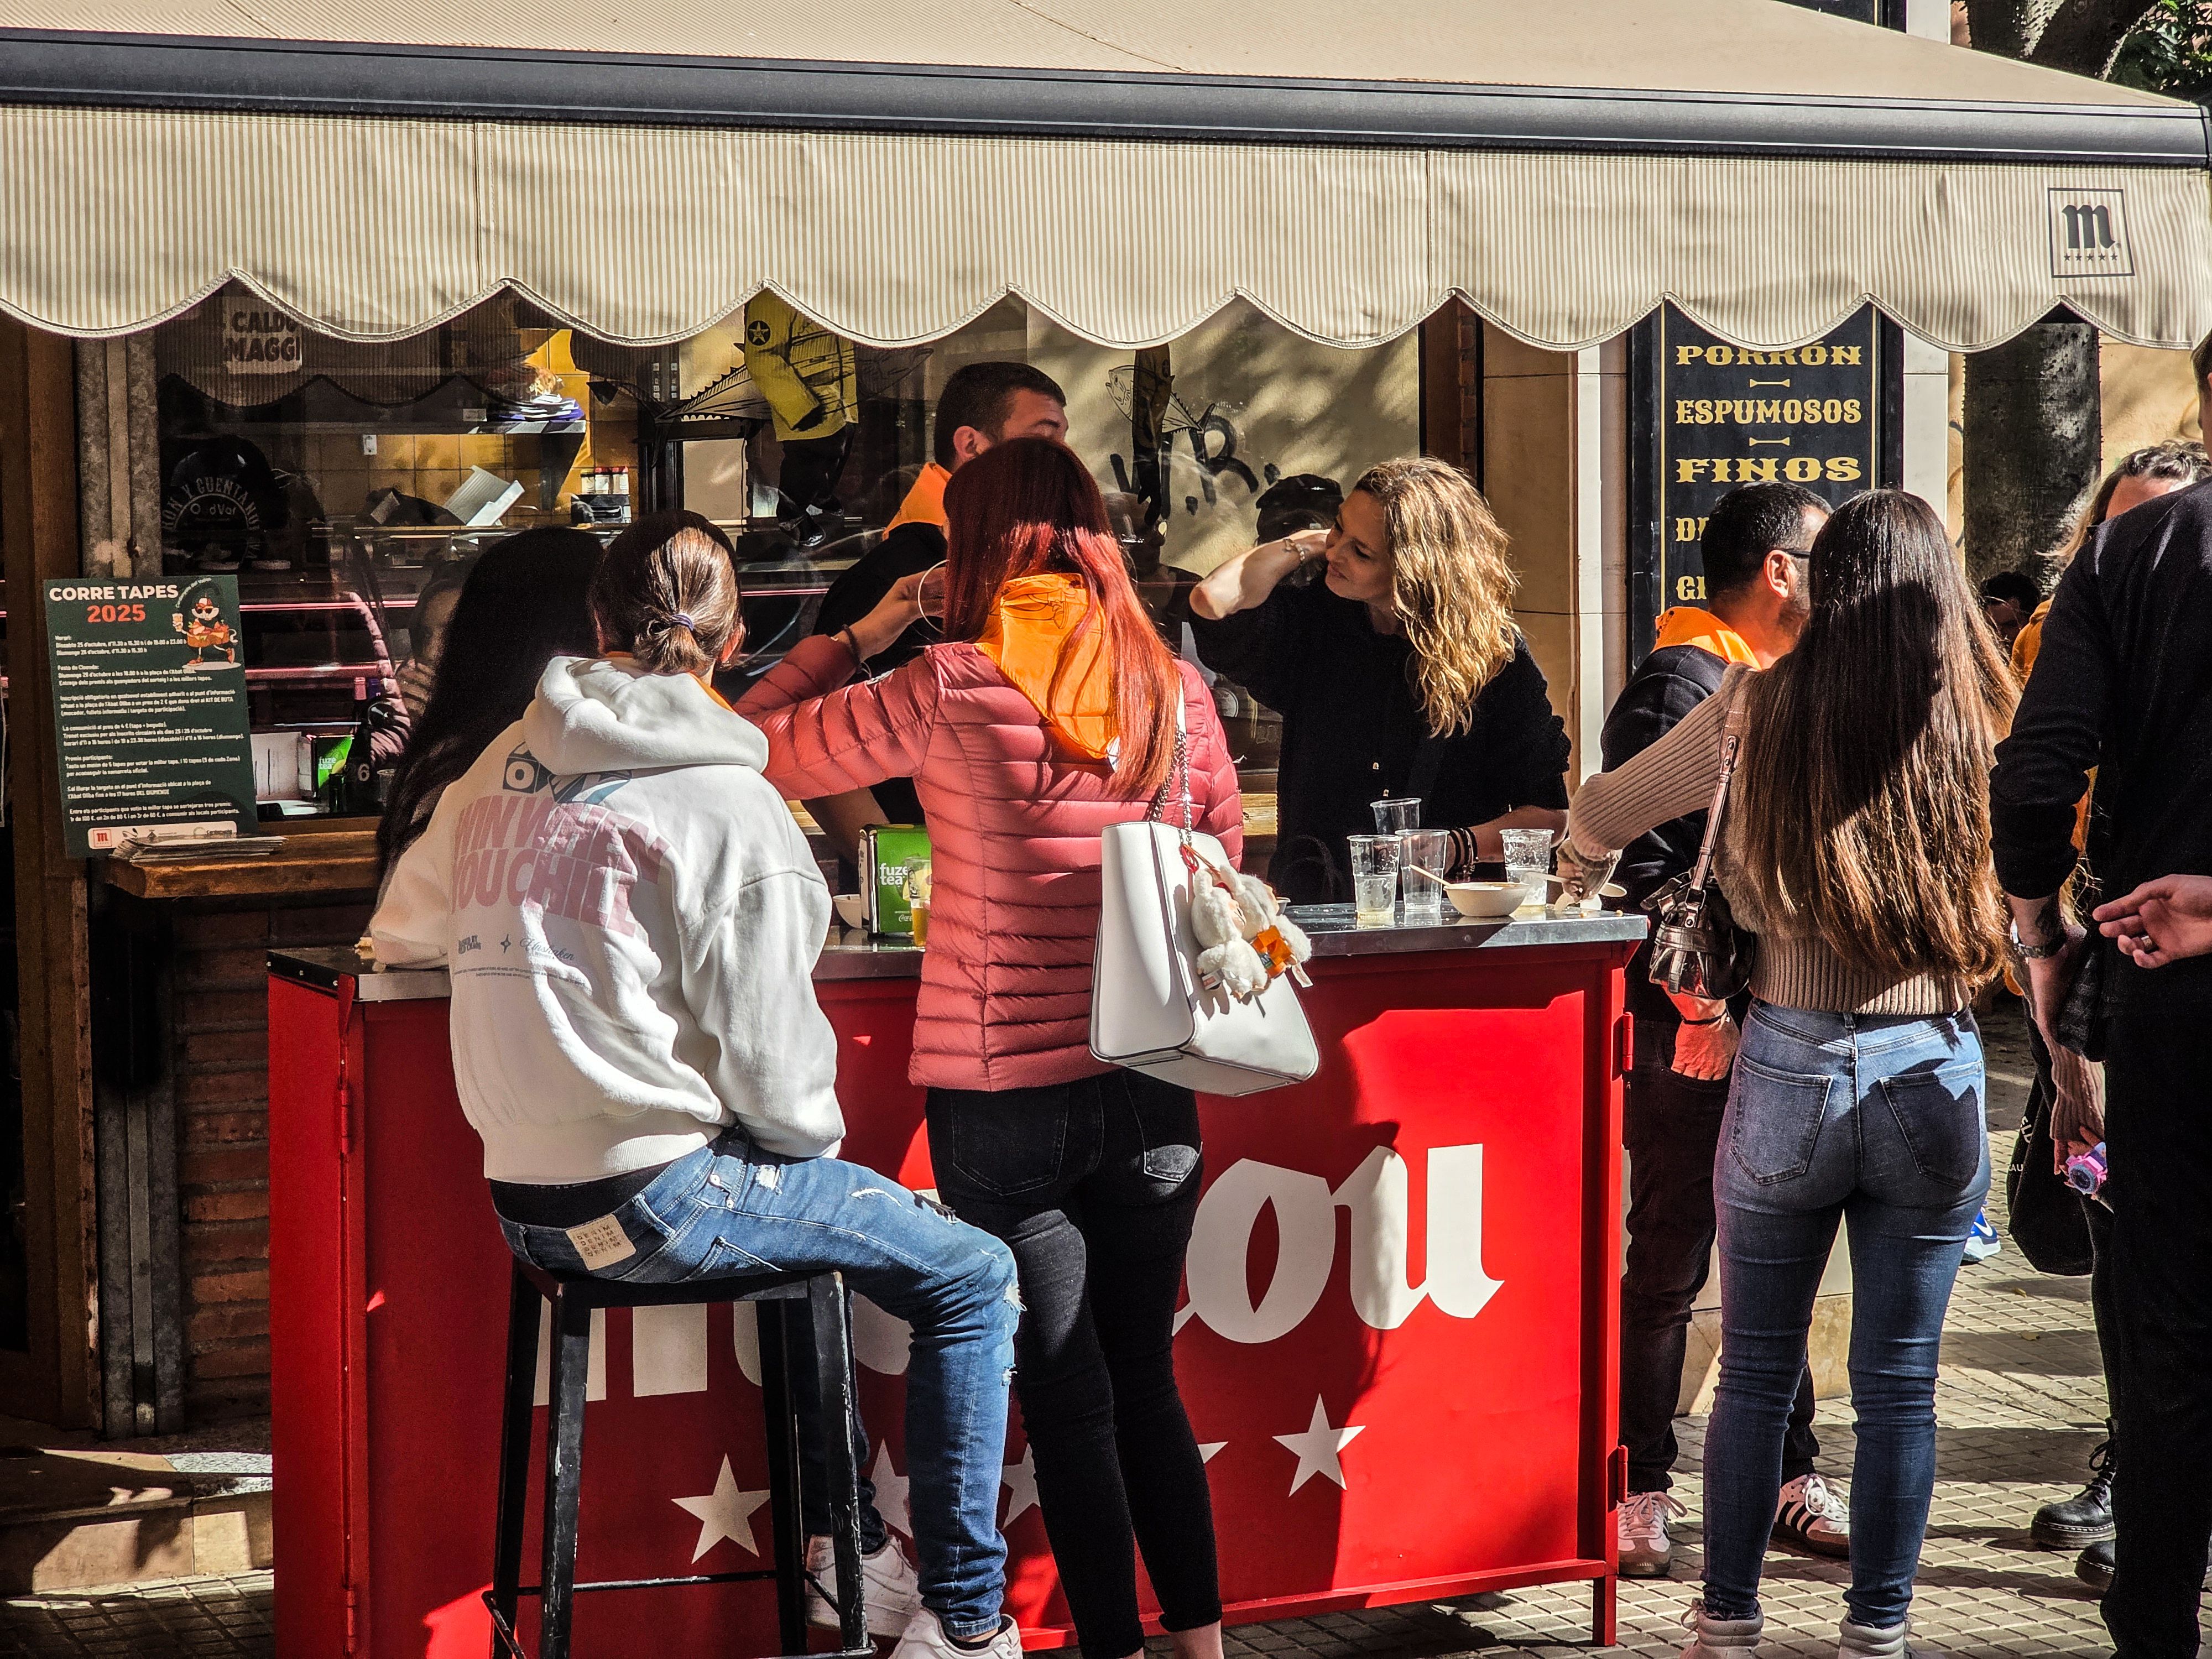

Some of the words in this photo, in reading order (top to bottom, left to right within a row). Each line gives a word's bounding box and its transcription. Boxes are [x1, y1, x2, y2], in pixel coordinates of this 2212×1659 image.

[225, 336, 300, 362] MAGGI
[1676, 341, 1862, 366] PORRÓN
[1676, 398, 1862, 424] ESPUMOSOS
[1675, 457, 1862, 483] FINOS
[49, 586, 114, 601] CORRE
[120, 585, 179, 600] TAPES
[87, 604, 146, 623] 2025
[879, 863, 908, 877] fuze
[880, 874, 904, 885] tea
